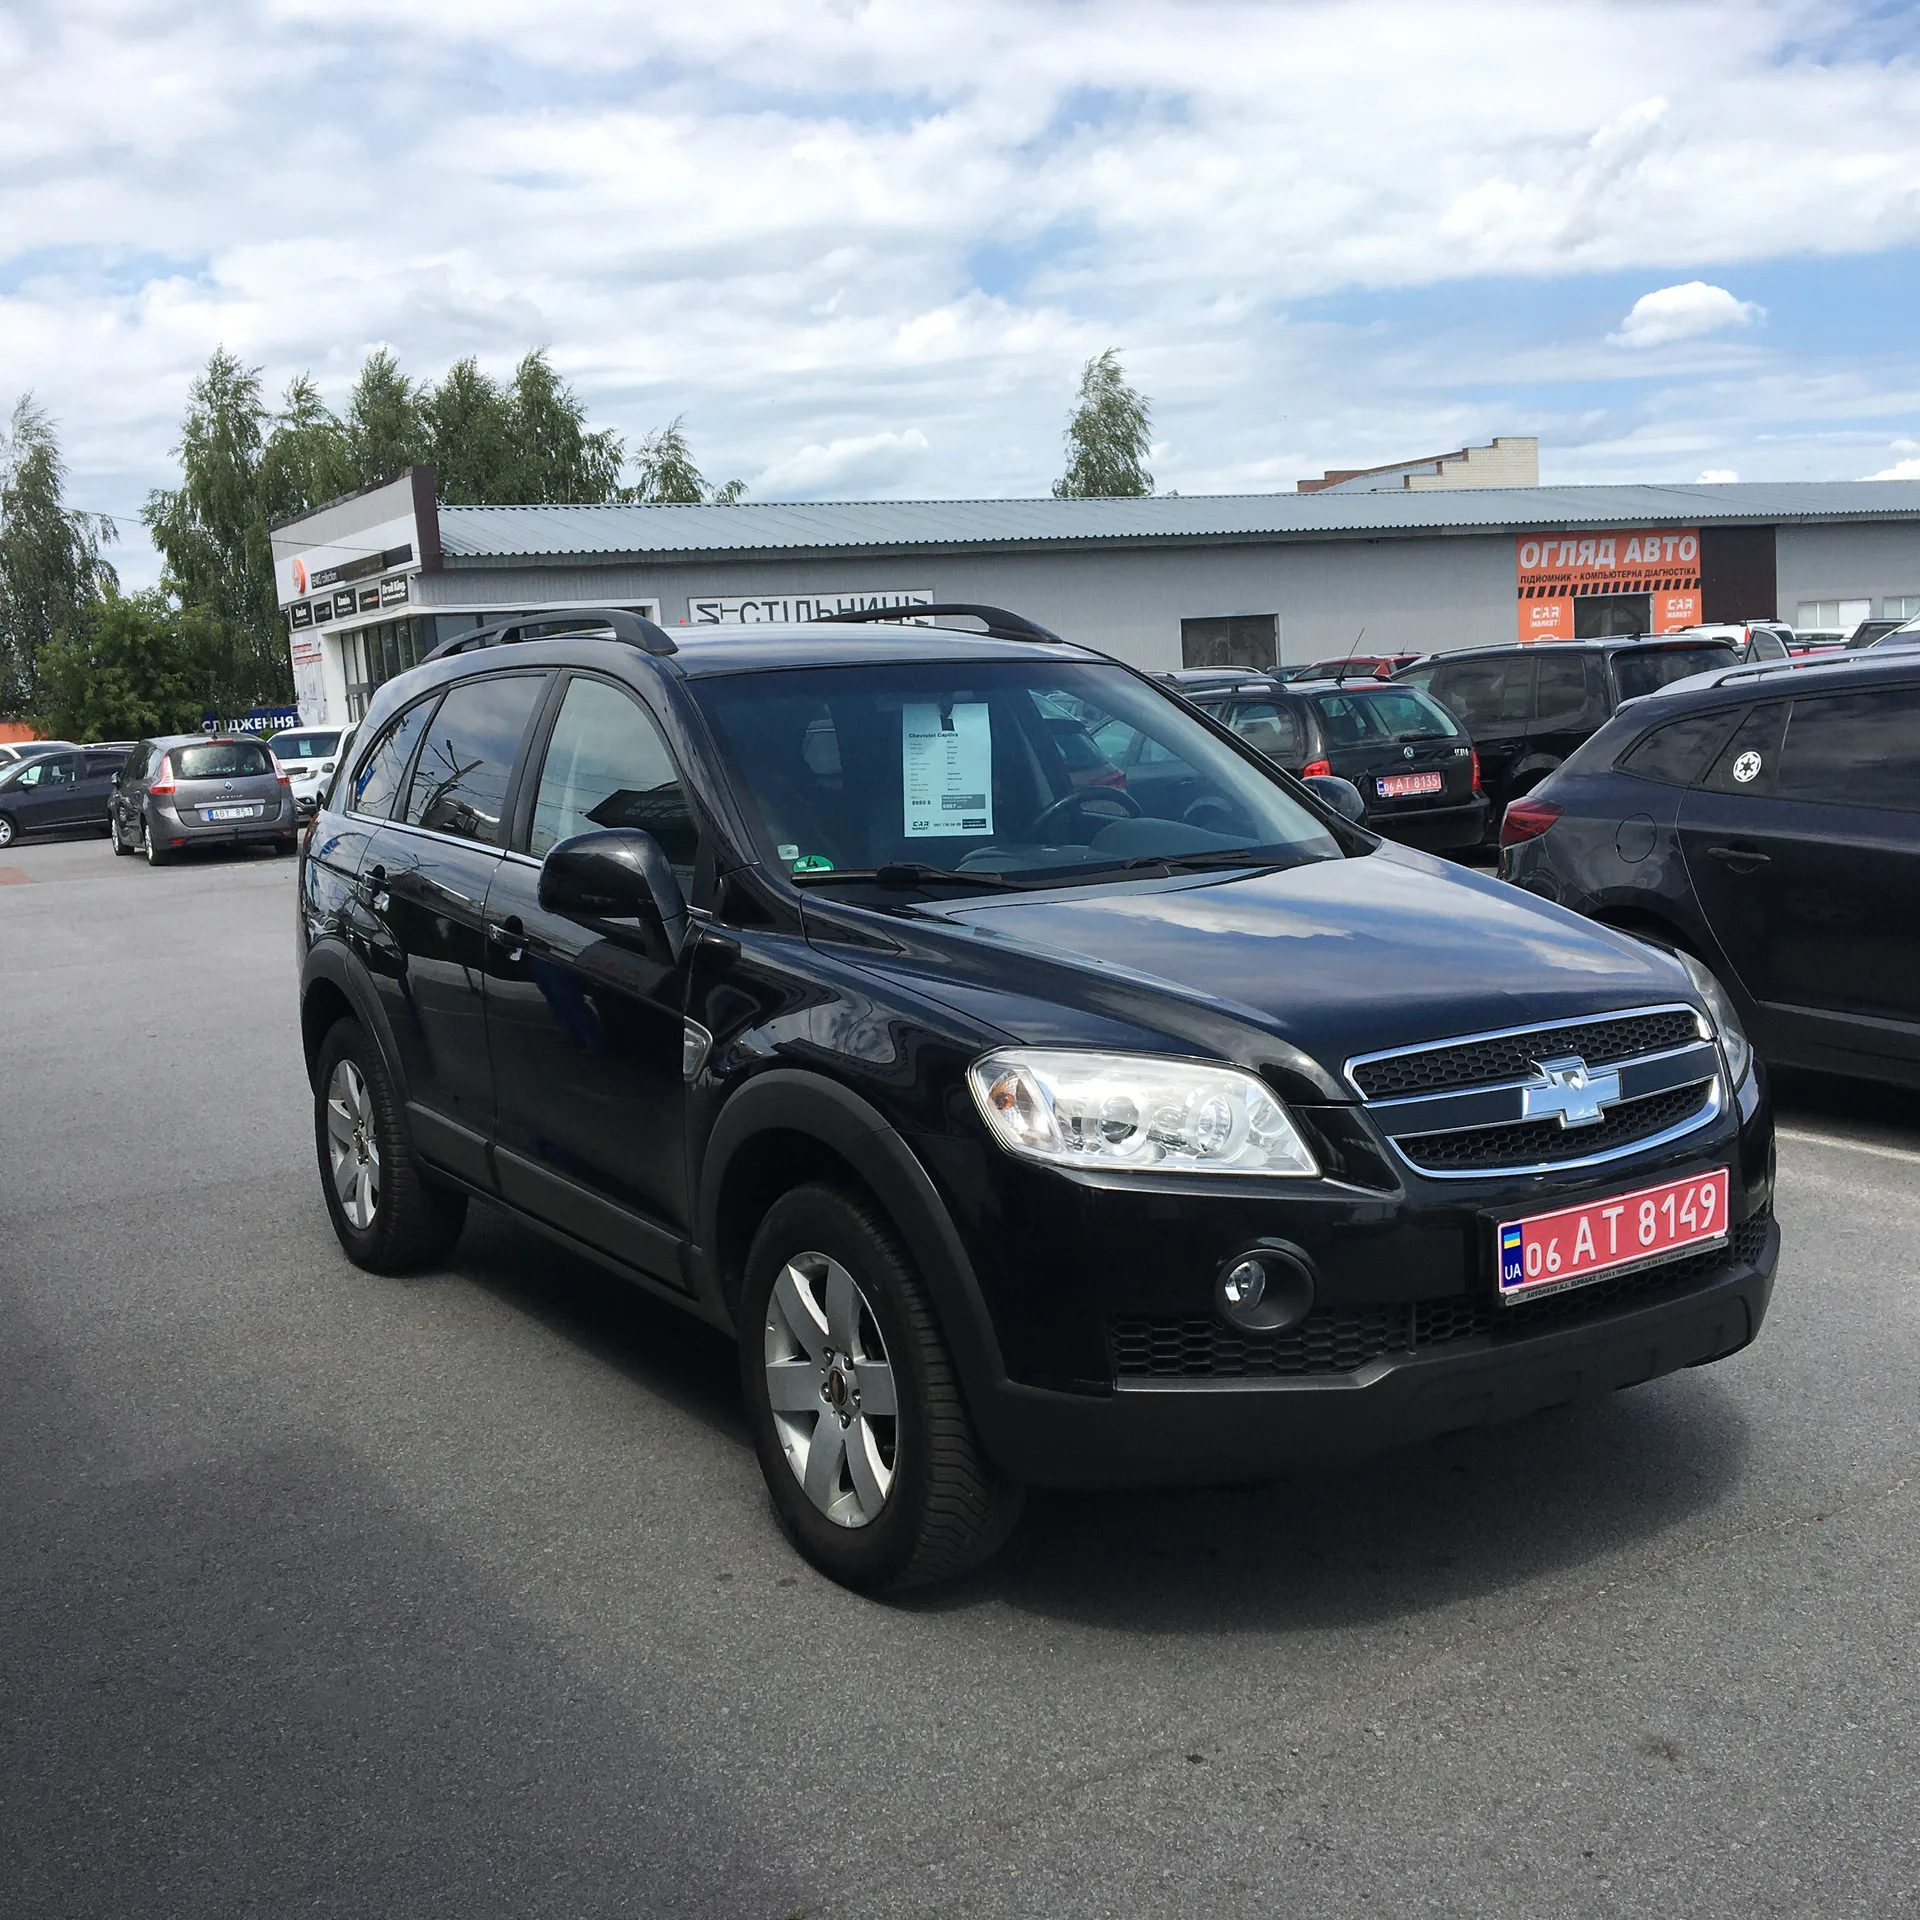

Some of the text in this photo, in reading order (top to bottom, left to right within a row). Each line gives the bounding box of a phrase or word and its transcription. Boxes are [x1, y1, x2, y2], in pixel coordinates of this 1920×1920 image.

[1520, 536, 1697, 570] ОГЛЯД АВТО
[1521, 573, 1572, 585] ПІДЙОМНИК
[1644, 567, 1696, 578] ДІАГНОСТІКА
[1668, 598, 1693, 610] CAR
[1533, 606, 1560, 619] CAR
[1667, 611, 1692, 619] MARKET
[1532, 619, 1559, 628] MARKET
[1384, 775, 1437, 792] 06 AT 8135
[236, 808, 252, 816] 851
[1526, 1183, 1716, 1278] 06 AT 8149
[1505, 1263, 1522, 1281] UA
